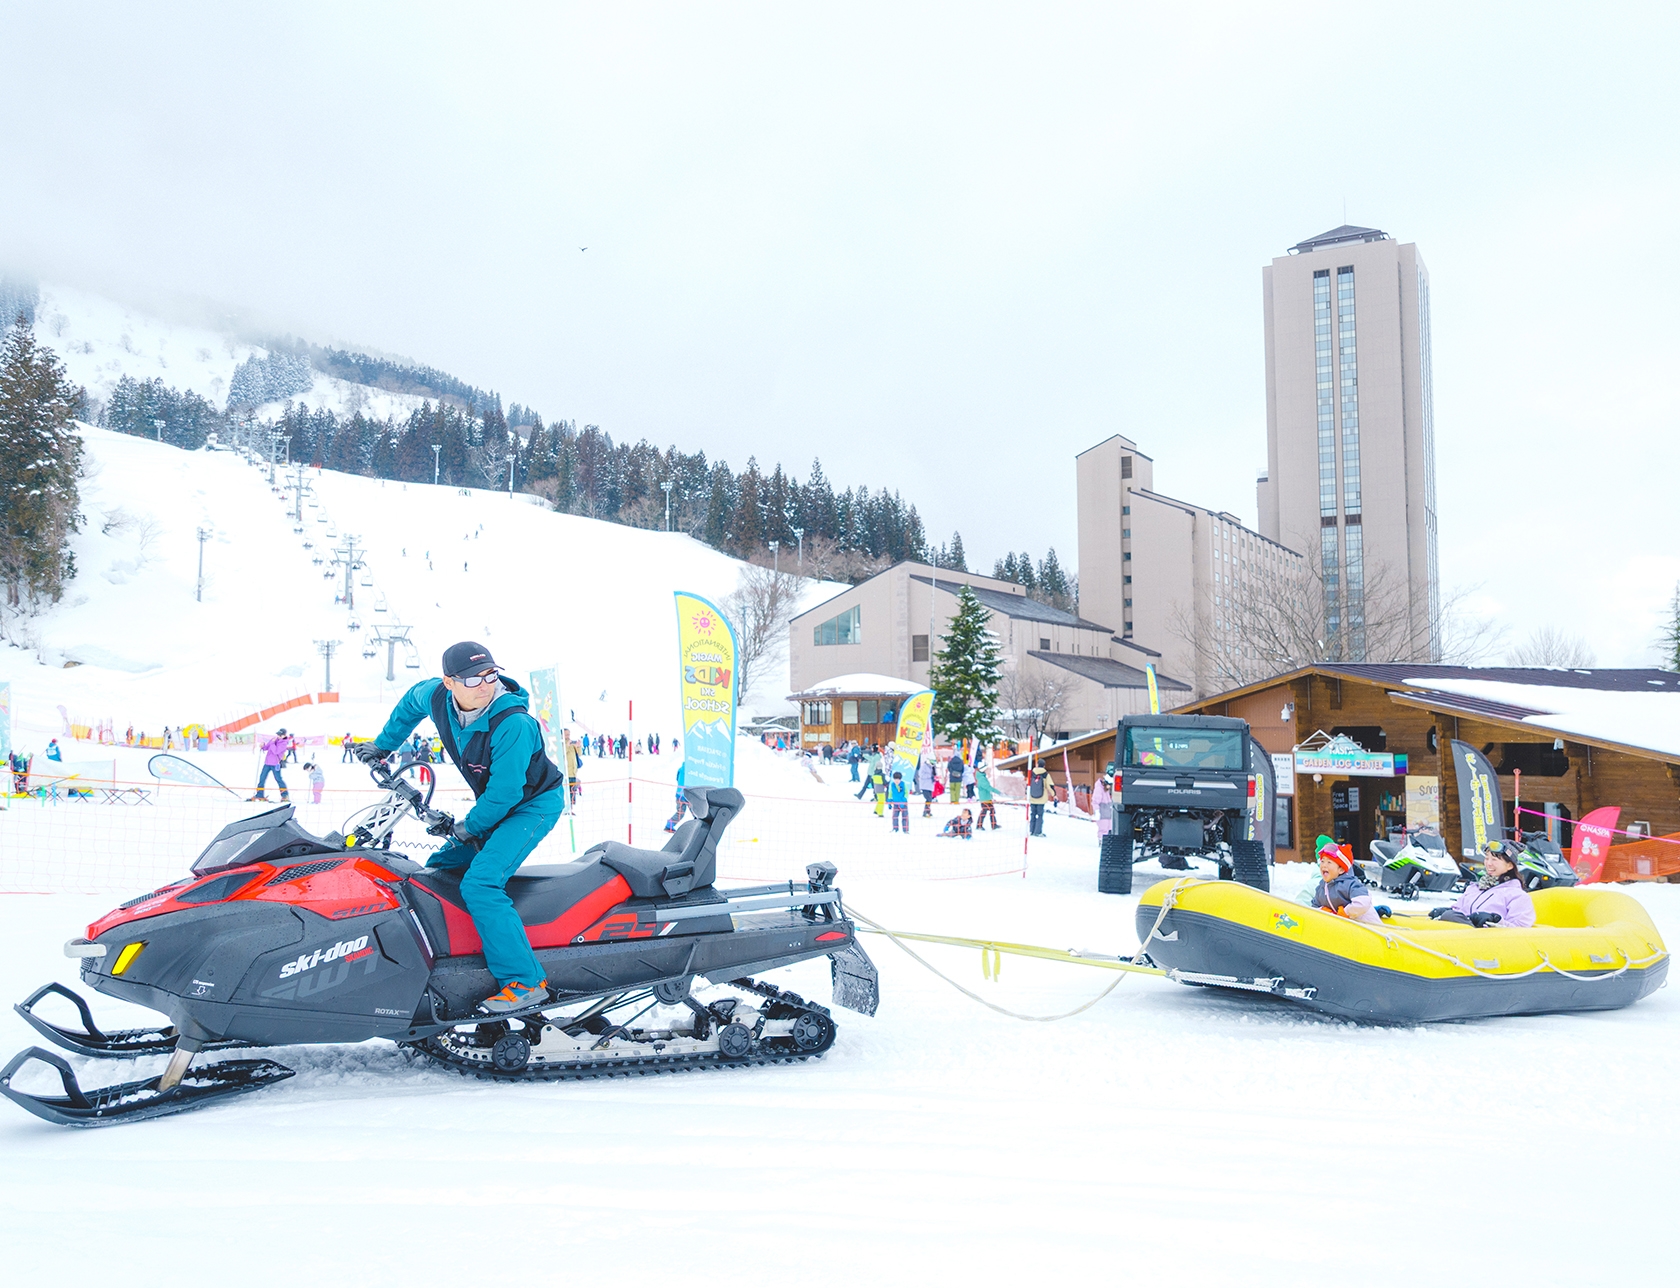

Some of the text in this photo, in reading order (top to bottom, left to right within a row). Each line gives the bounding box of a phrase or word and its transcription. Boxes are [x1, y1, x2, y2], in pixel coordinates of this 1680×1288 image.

[900, 726, 923, 741] KIDS
[1302, 757, 1333, 769] GARDEN
[1334, 758, 1352, 770] LOG
[1354, 760, 1385, 771] CENTER
[1333, 802, 1349, 810] Space
[1587, 826, 1610, 838] NASPA
[279, 935, 369, 979] ski-doo
[344, 946, 375, 964] SKANDIC
[374, 1007, 400, 1016] ROTAX
